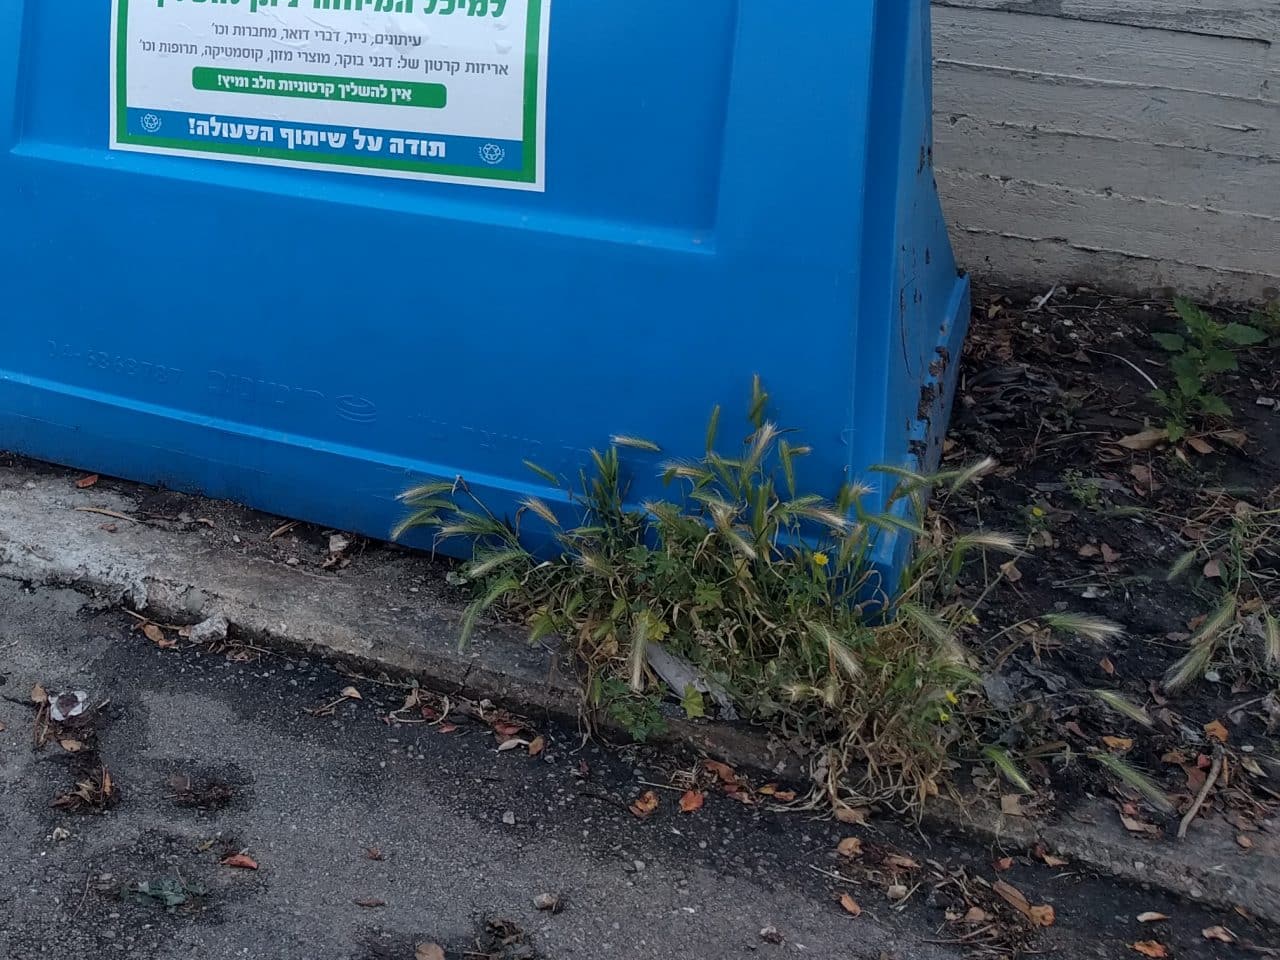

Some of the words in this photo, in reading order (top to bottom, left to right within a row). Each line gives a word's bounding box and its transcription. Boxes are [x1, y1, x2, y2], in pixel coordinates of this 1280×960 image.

[232, 24, 277, 38] מחברות
[280, 27, 310, 41] דואר,
[314, 29, 340, 42] דברי
[343, 31, 367, 45] נייר,
[370, 32, 422, 47] עיתונים,
[159, 41, 198, 56] תרופות
[201, 44, 263, 61] קוסמטיקה,
[267, 48, 293, 63] מזון,
[297, 50, 331, 64] מוצרי
[334, 52, 365, 69] בוקר,
[369, 55, 393, 69] דגני
[397, 54, 419, 70] של:
[424, 58, 460, 76] קרטון
[465, 60, 509, 76] אריזות
[217, 73, 249, 89] ומיץ!
[251, 75, 276, 90] חלב
[278, 78, 335, 97] קרטוניות
[338, 81, 388, 98] להשליך
[392, 87, 412, 102] אין
[188, 116, 274, 142] הפעולה!
[280, 125, 347, 150] שיתוף
[352, 129, 383, 152] על
[389, 139, 446, 157] תודה
